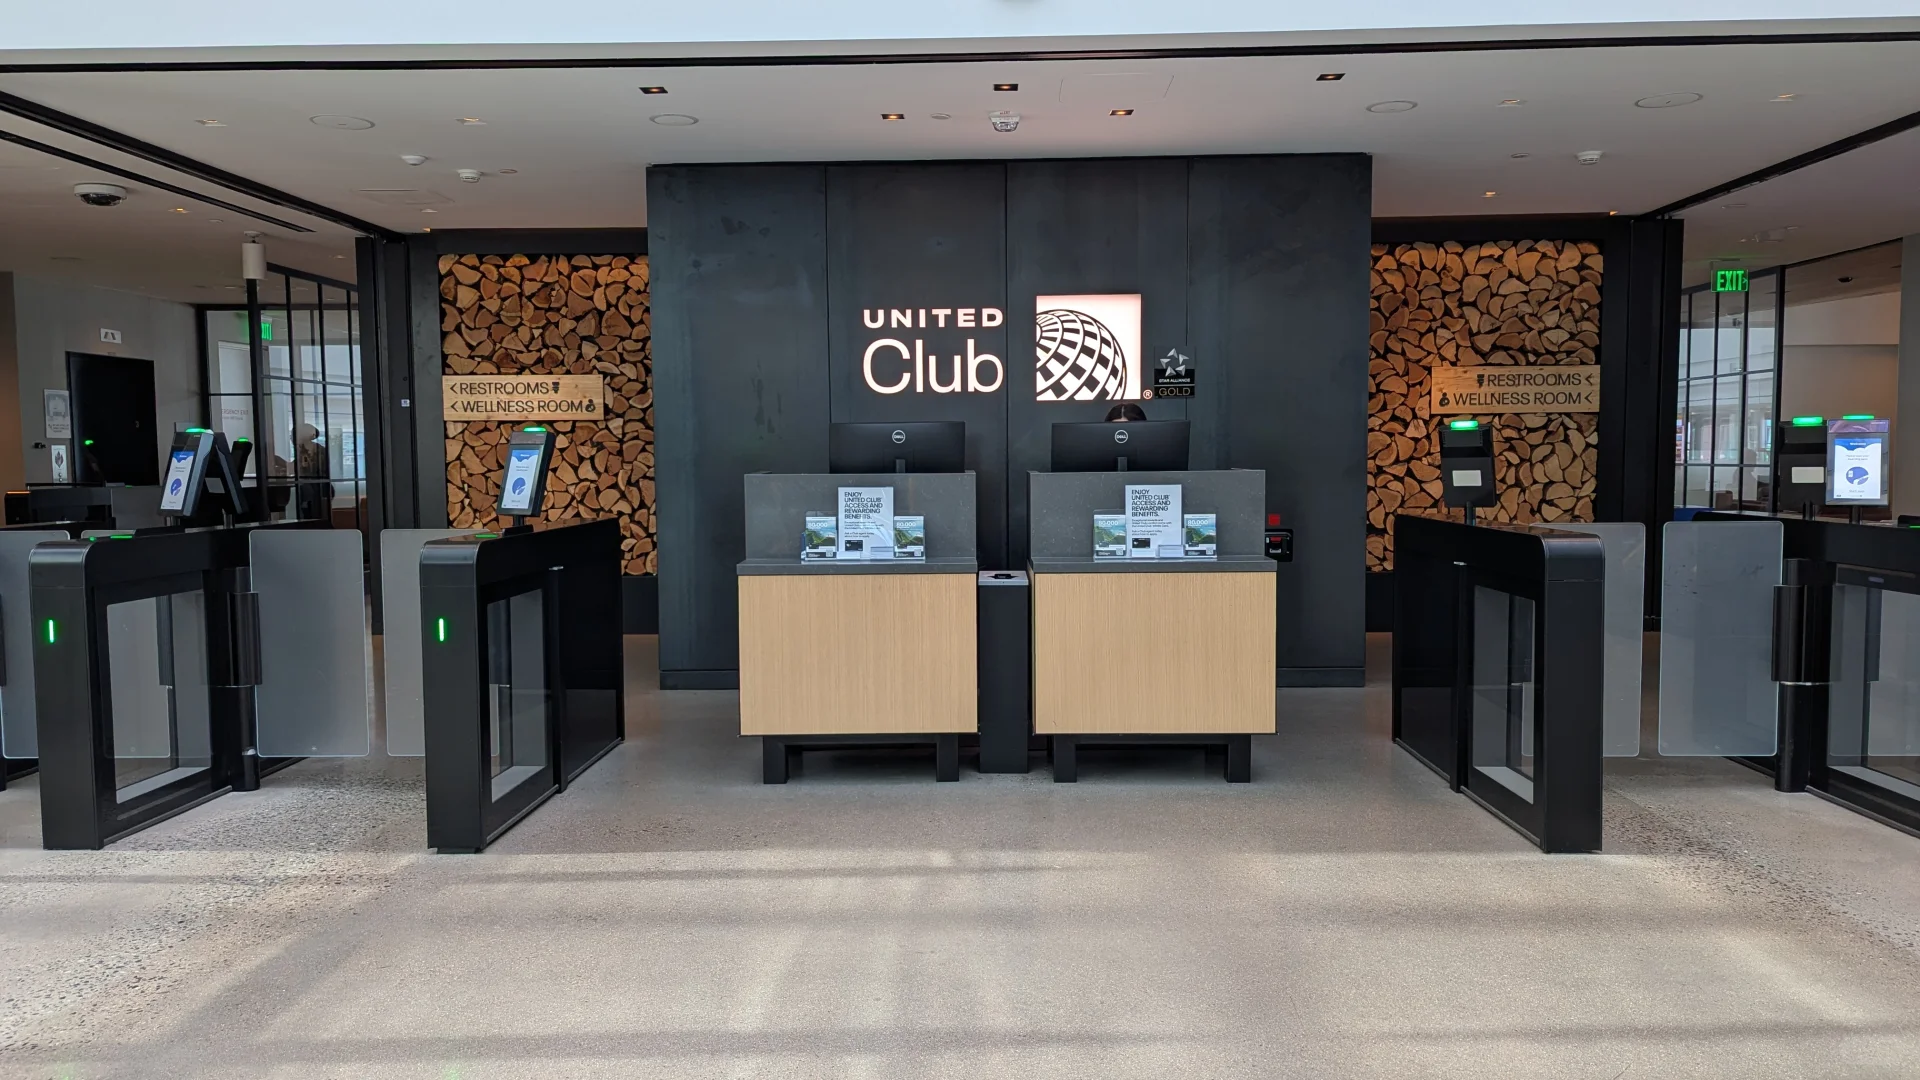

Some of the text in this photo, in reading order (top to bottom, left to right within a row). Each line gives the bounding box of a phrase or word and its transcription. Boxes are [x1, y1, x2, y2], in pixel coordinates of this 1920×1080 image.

[1717, 270, 1744, 291] EXIT
[863, 308, 1004, 329] UNITED
[862, 338, 1004, 394] Club
[1488, 373, 1582, 387] RESTROOMS
[459, 381, 549, 395] RESTROOMS
[1159, 387, 1190, 396] GOLD
[1453, 391, 1581, 406] WELLNESS ROOM
[461, 399, 583, 413] WELLNESS ROOM
